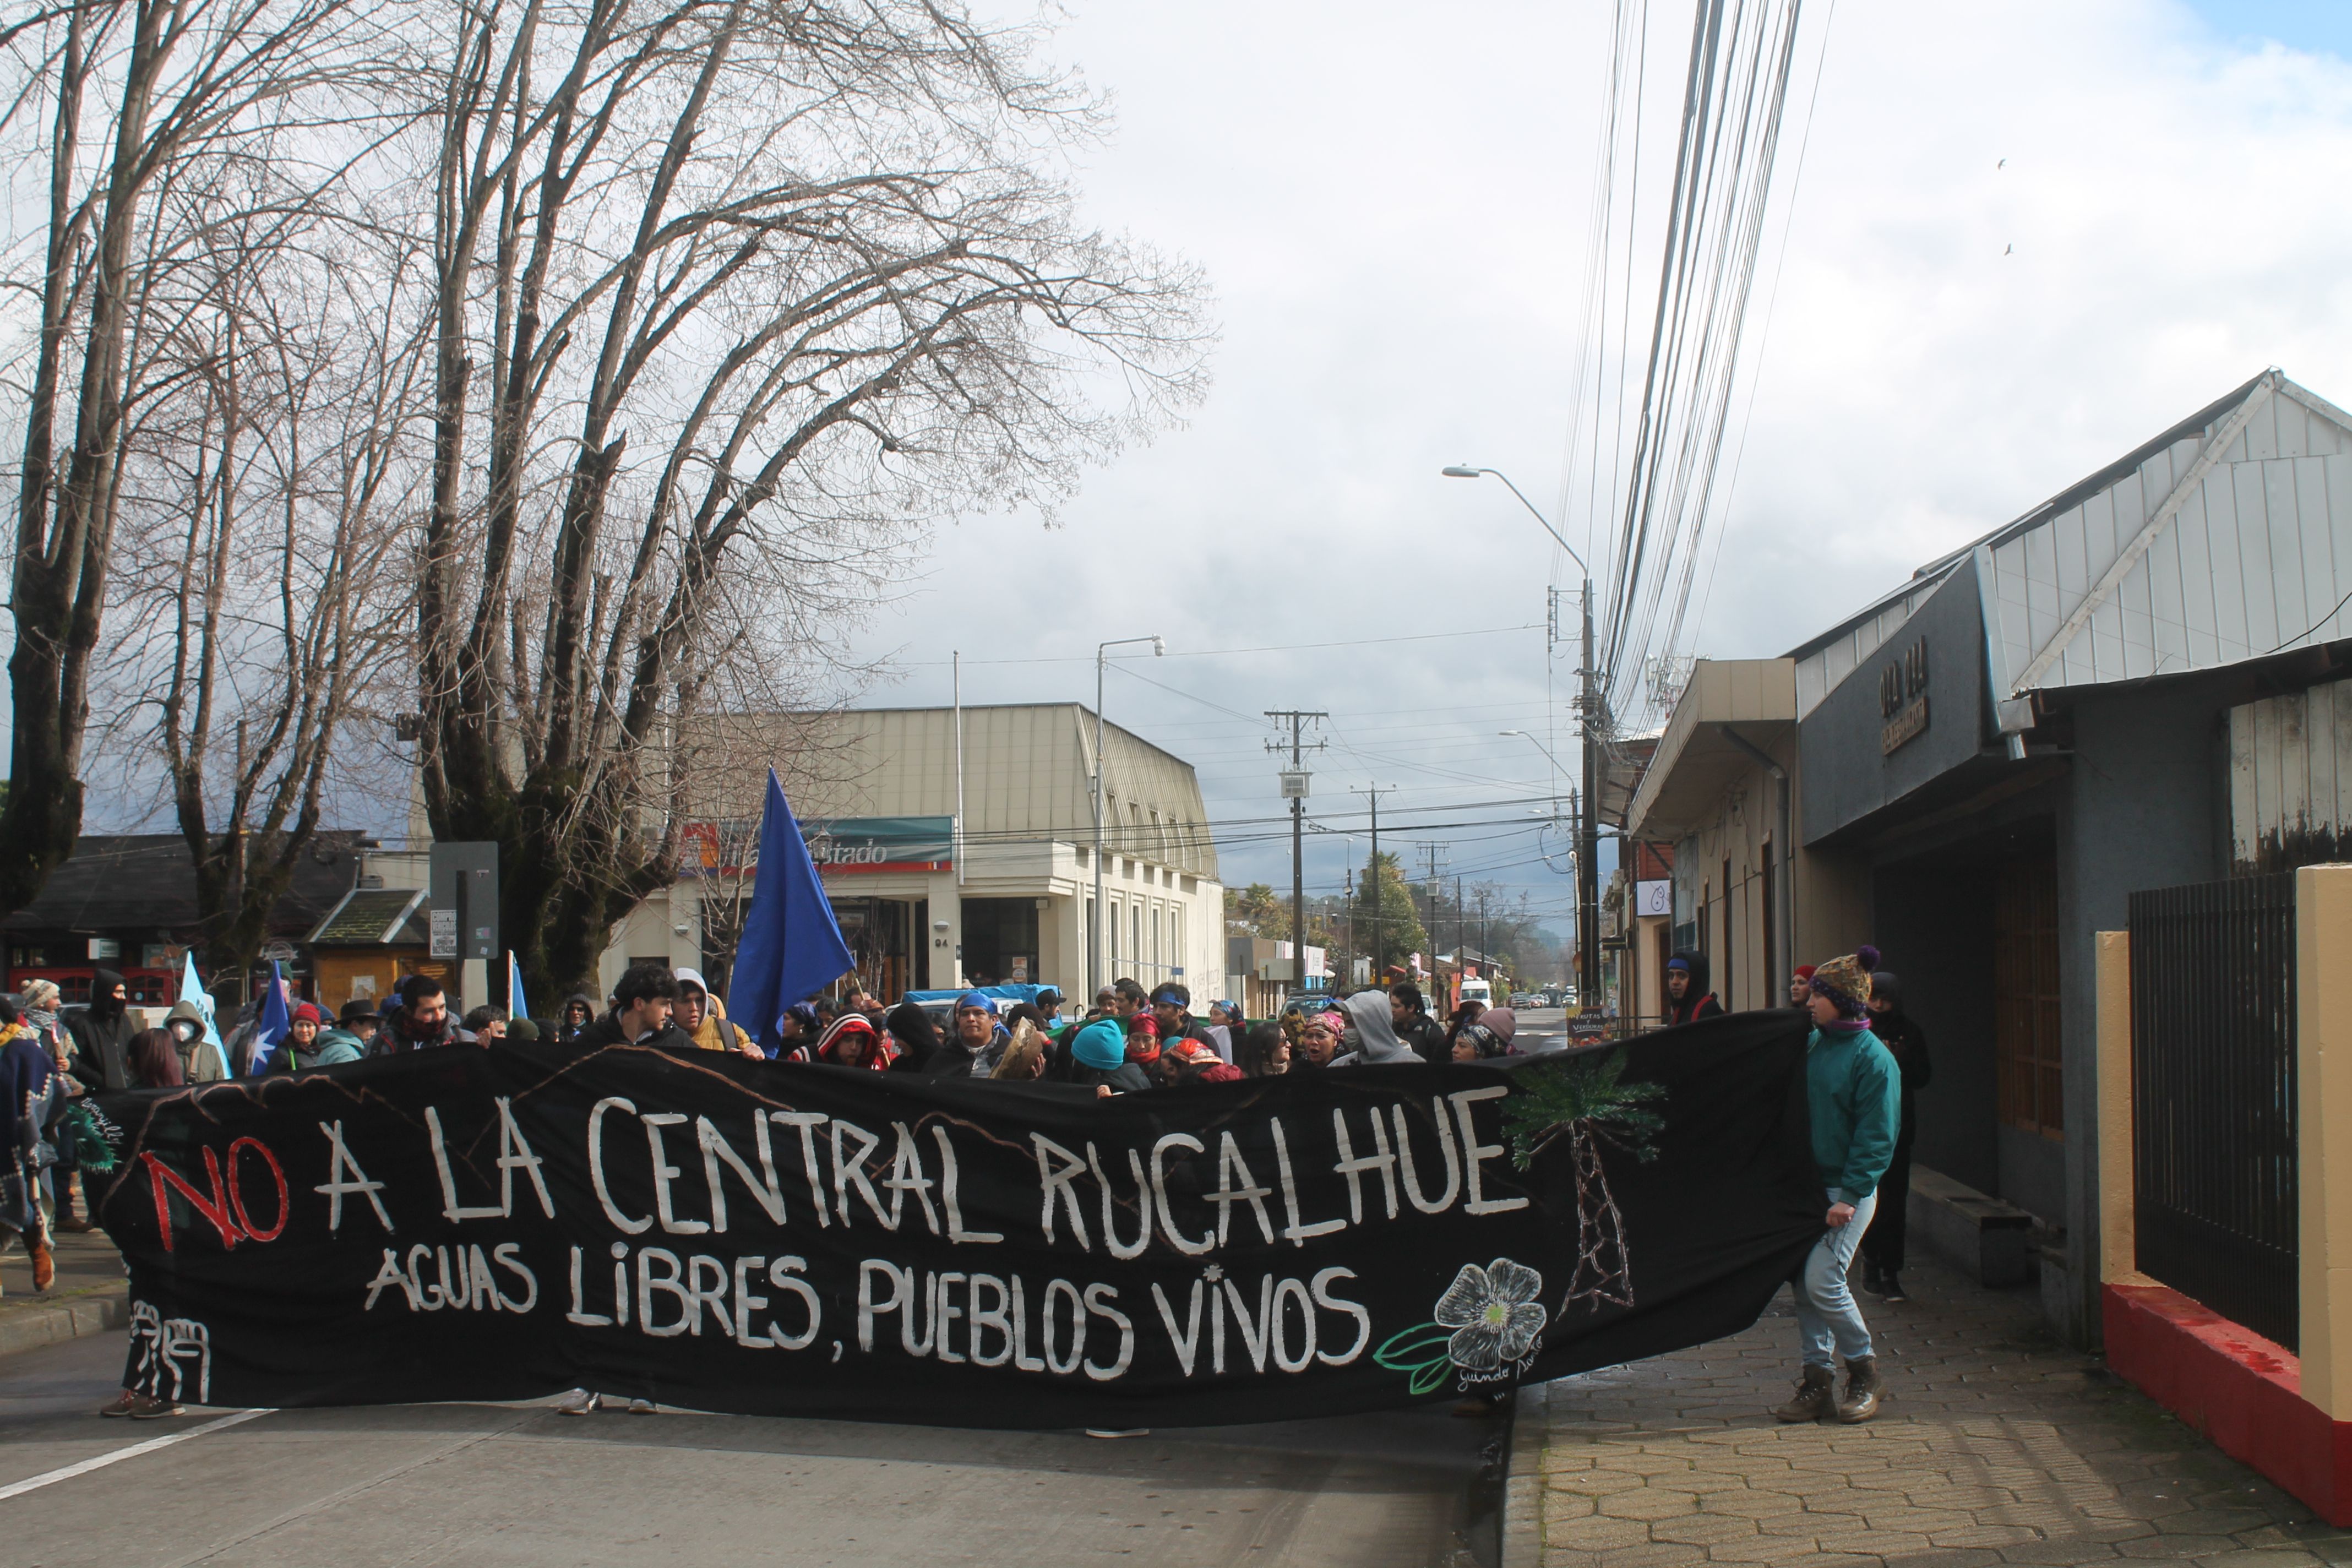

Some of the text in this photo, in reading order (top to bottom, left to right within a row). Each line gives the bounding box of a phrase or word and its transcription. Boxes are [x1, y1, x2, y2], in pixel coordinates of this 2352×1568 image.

[139, 1086, 1530, 1261] NO A LA CENTRAL RUCALHUE
[365, 1242, 538, 1313] AGUAS
[857, 1259, 1135, 1381] PUEBLOS
